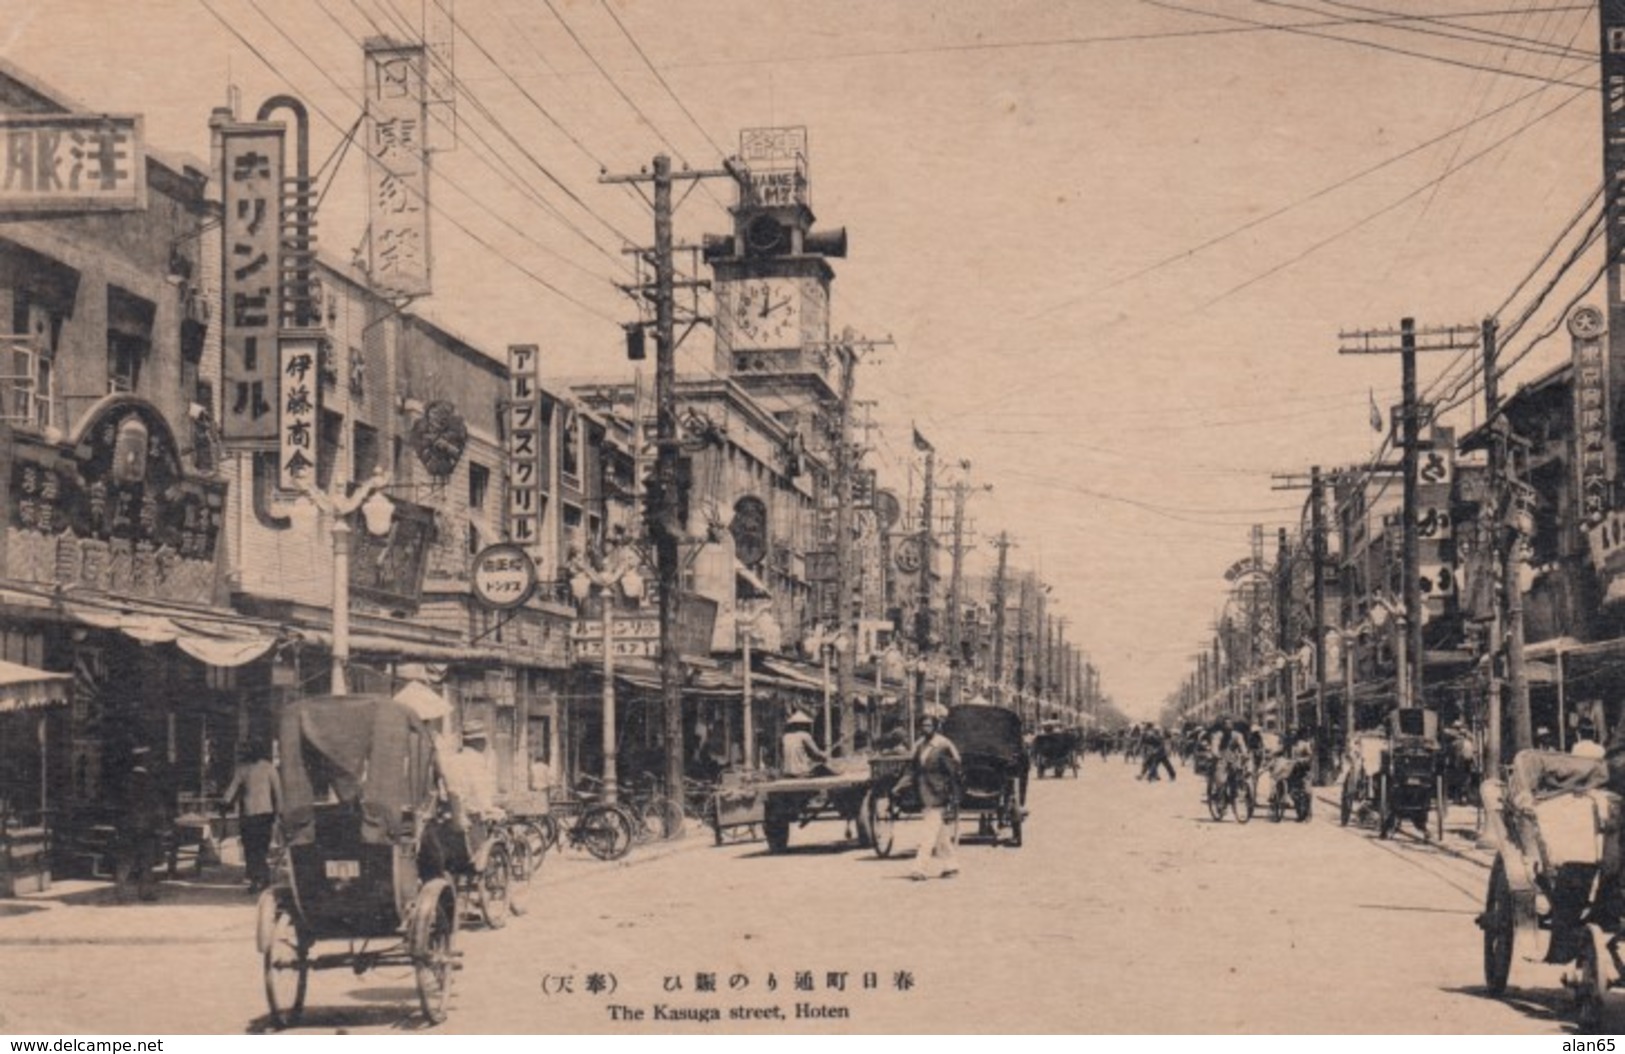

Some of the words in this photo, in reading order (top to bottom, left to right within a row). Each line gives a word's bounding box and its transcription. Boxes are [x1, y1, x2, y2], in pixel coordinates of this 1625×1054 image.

[4, 128, 127, 191] 洋服
[233, 152, 271, 421] キリンビール
